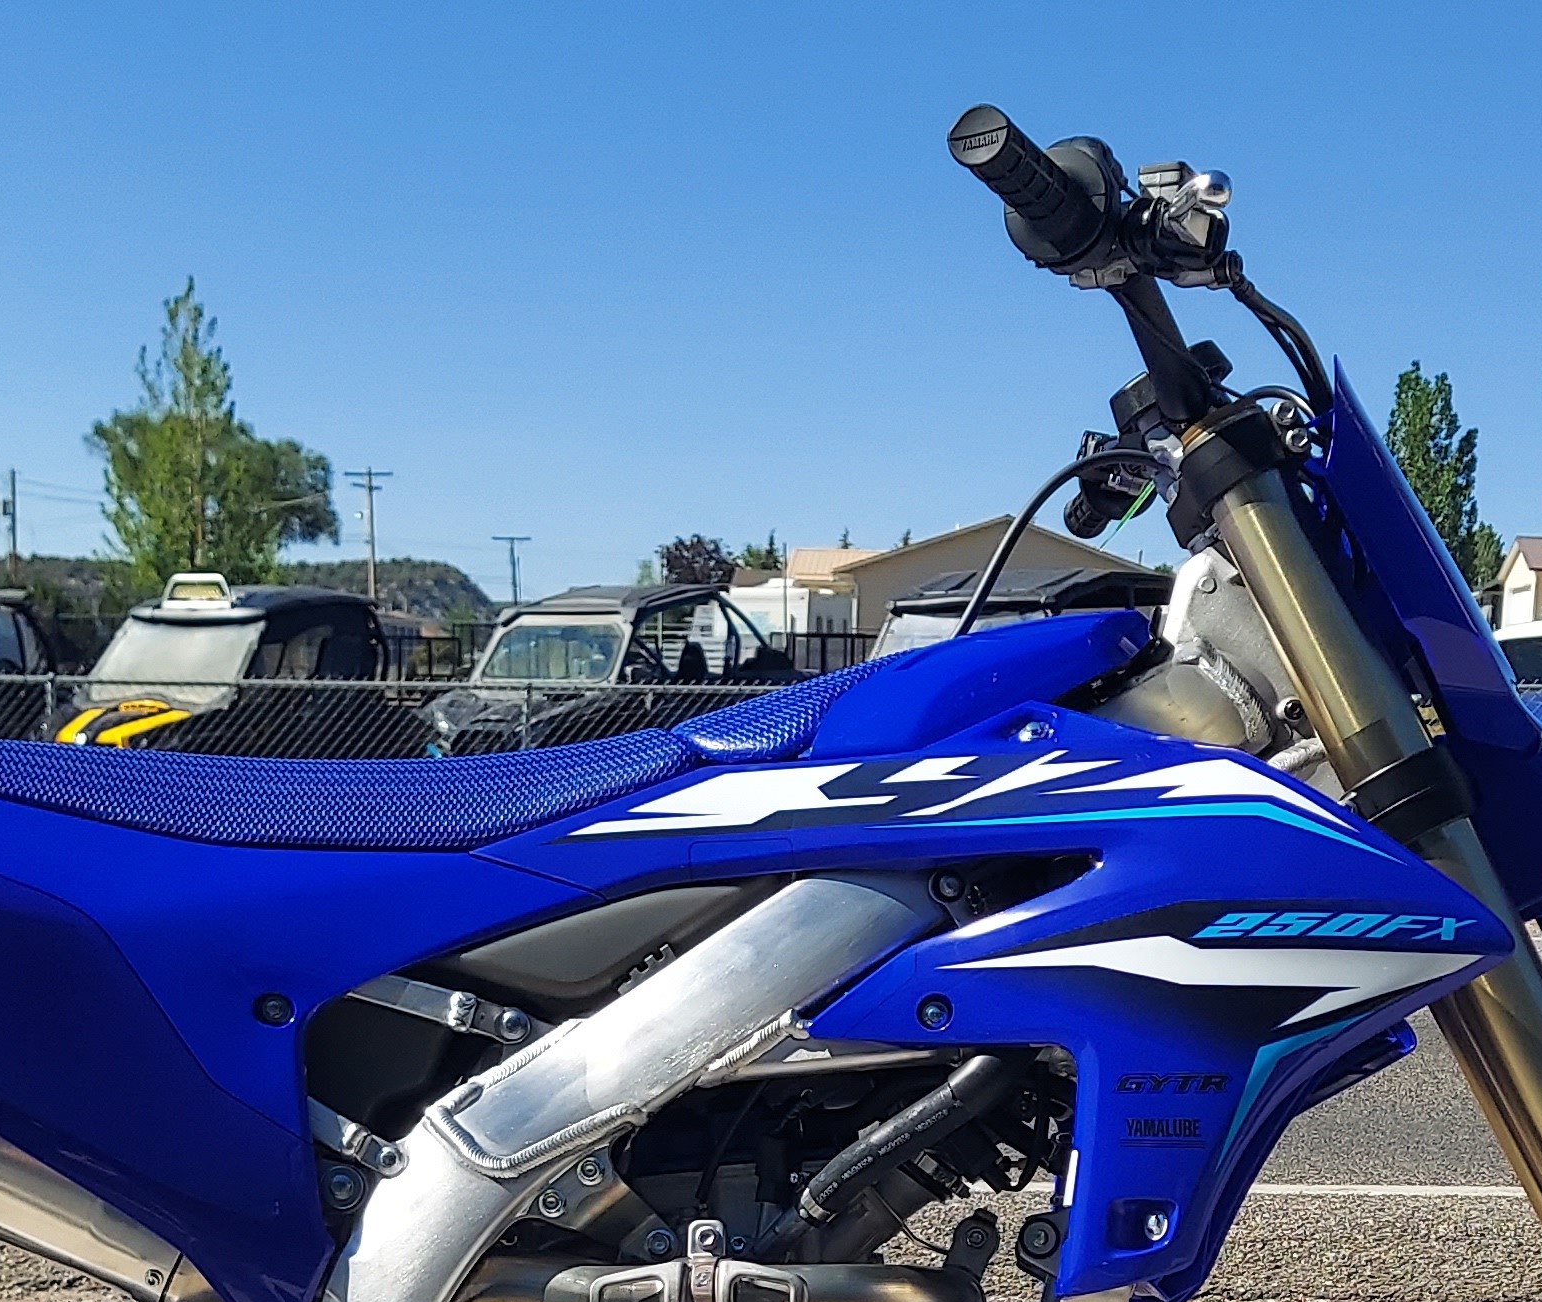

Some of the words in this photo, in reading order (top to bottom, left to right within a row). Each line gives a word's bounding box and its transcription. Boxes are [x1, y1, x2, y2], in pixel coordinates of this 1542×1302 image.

[1190, 911, 1478, 941] 250FX
[1114, 1071, 1230, 1093] GYTR
[1125, 1117, 1202, 1138] YAMALUBE
